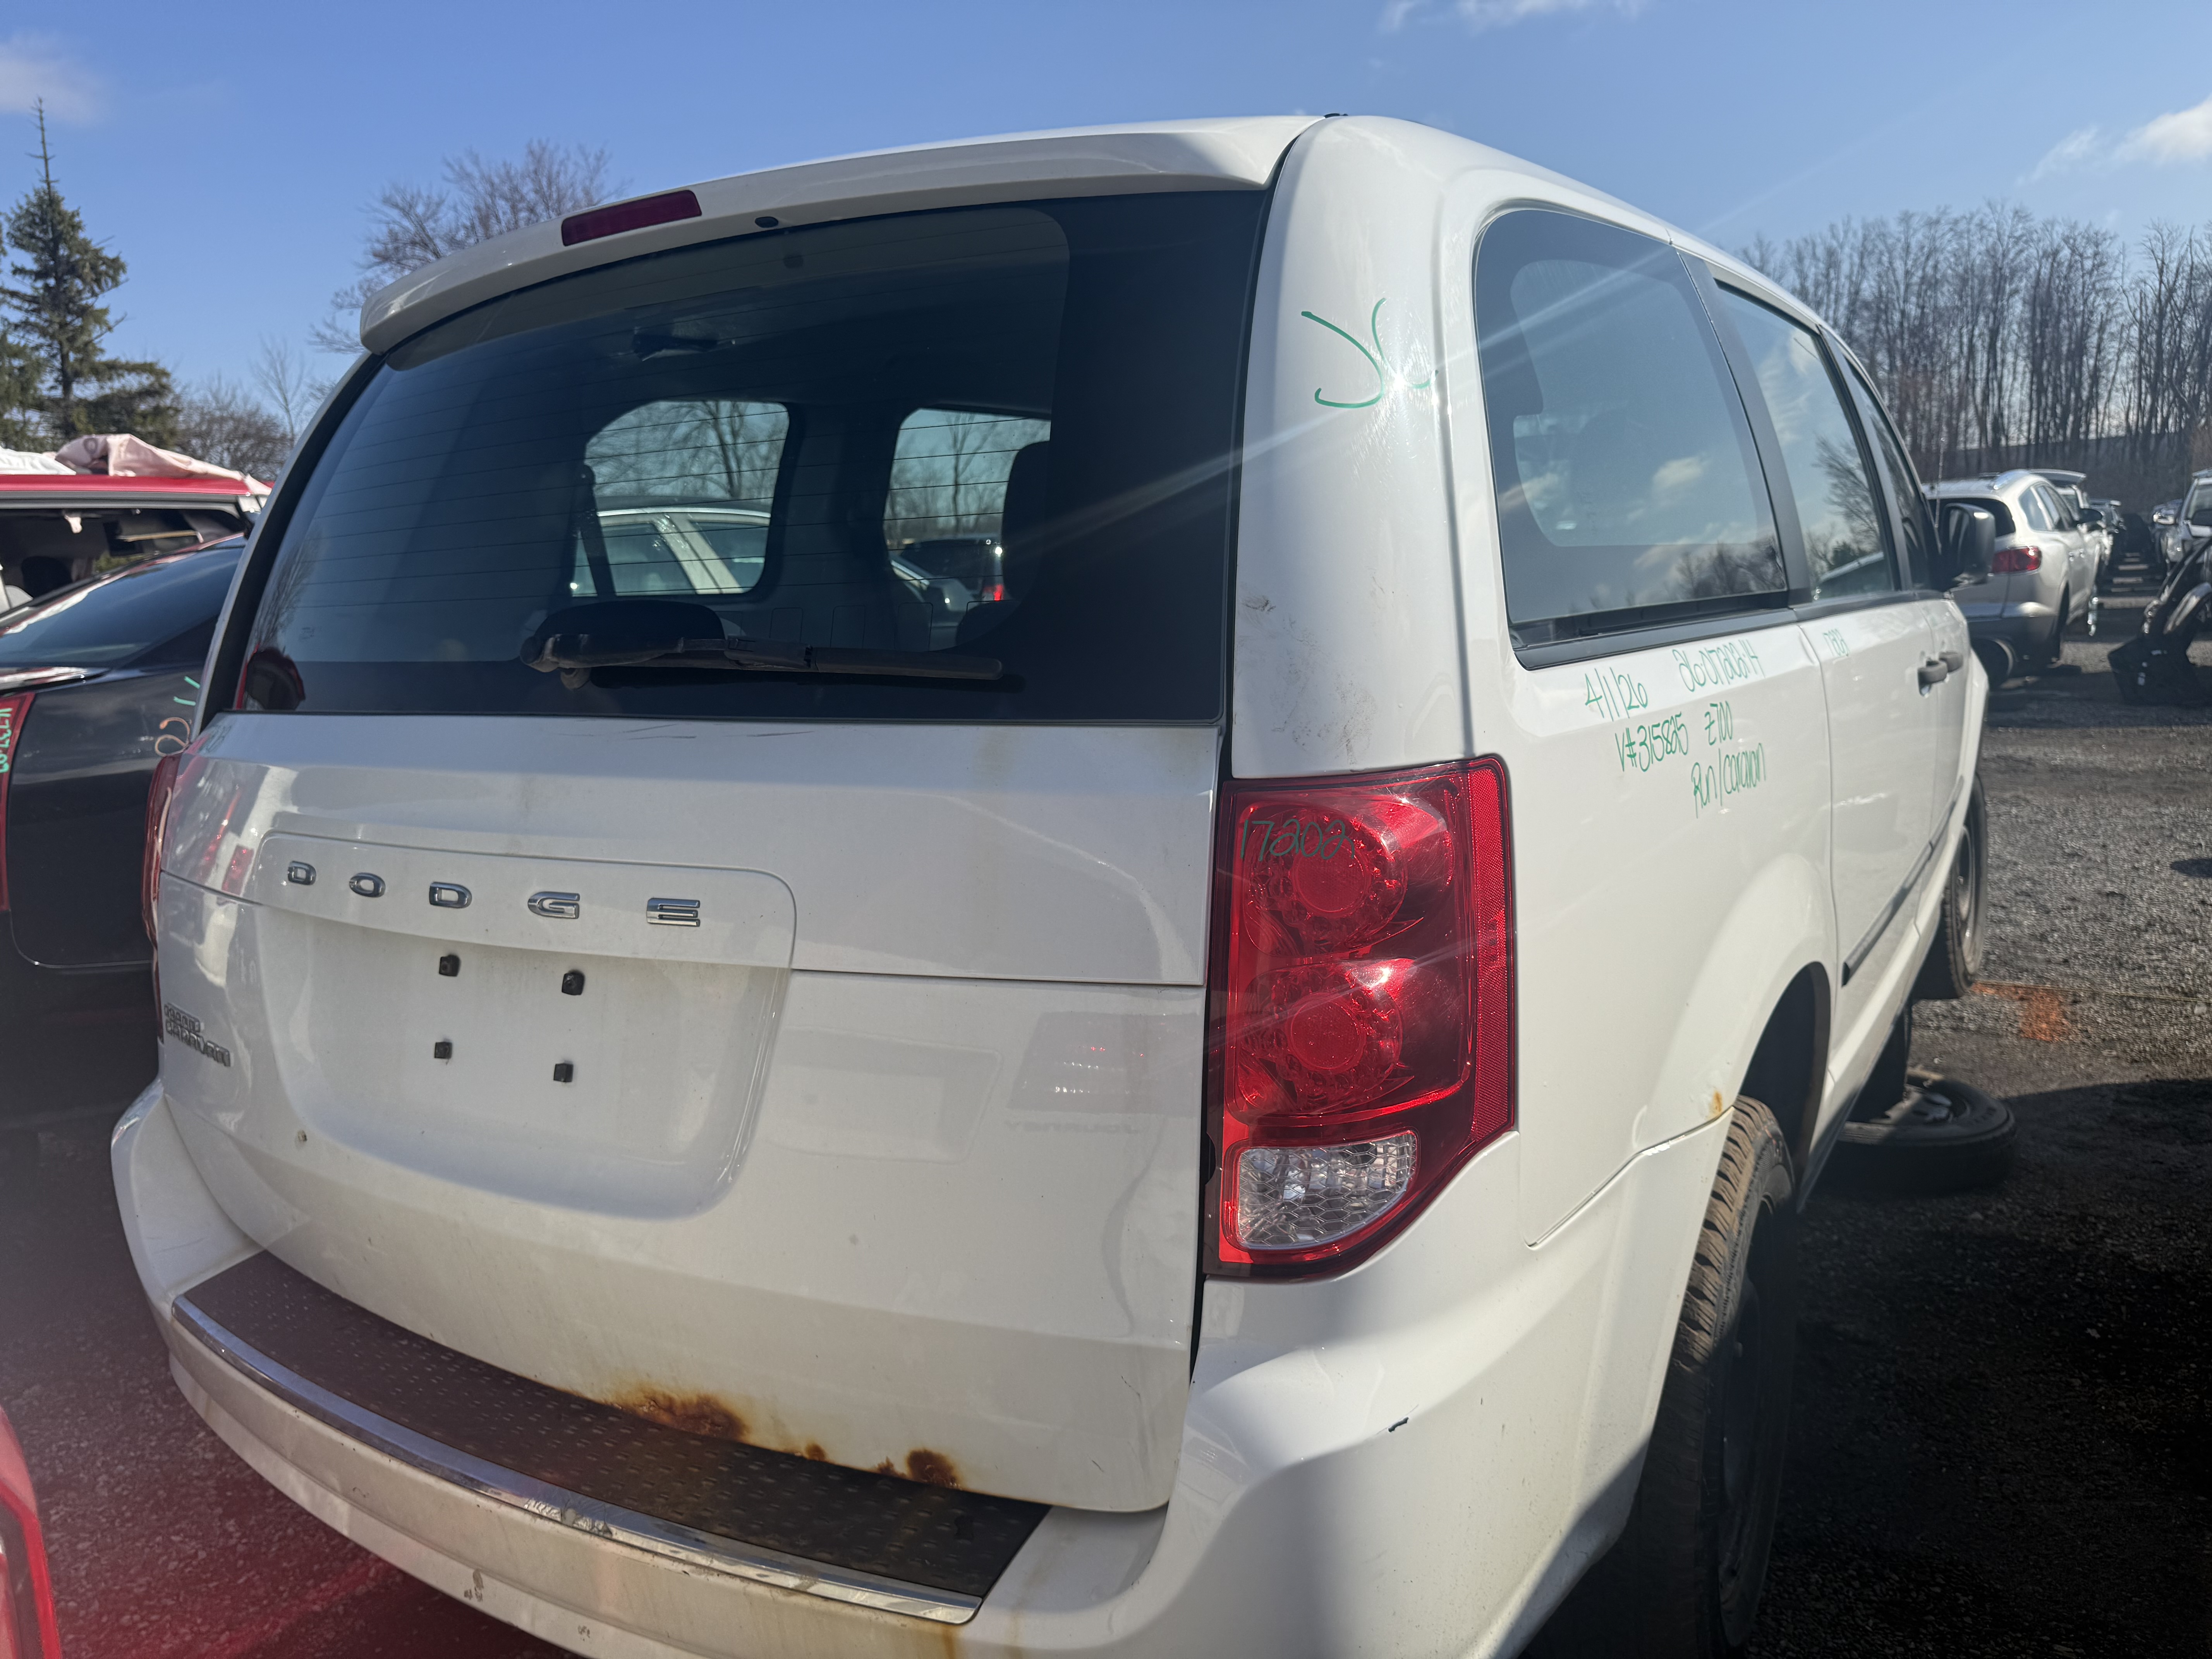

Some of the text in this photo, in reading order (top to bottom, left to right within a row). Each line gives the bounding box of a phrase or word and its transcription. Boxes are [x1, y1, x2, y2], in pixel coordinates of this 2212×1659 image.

[1585, 667, 1648, 721] 4/1/26
[1240, 818, 1355, 862] 17202
[287, 860, 701, 927] DODGE
